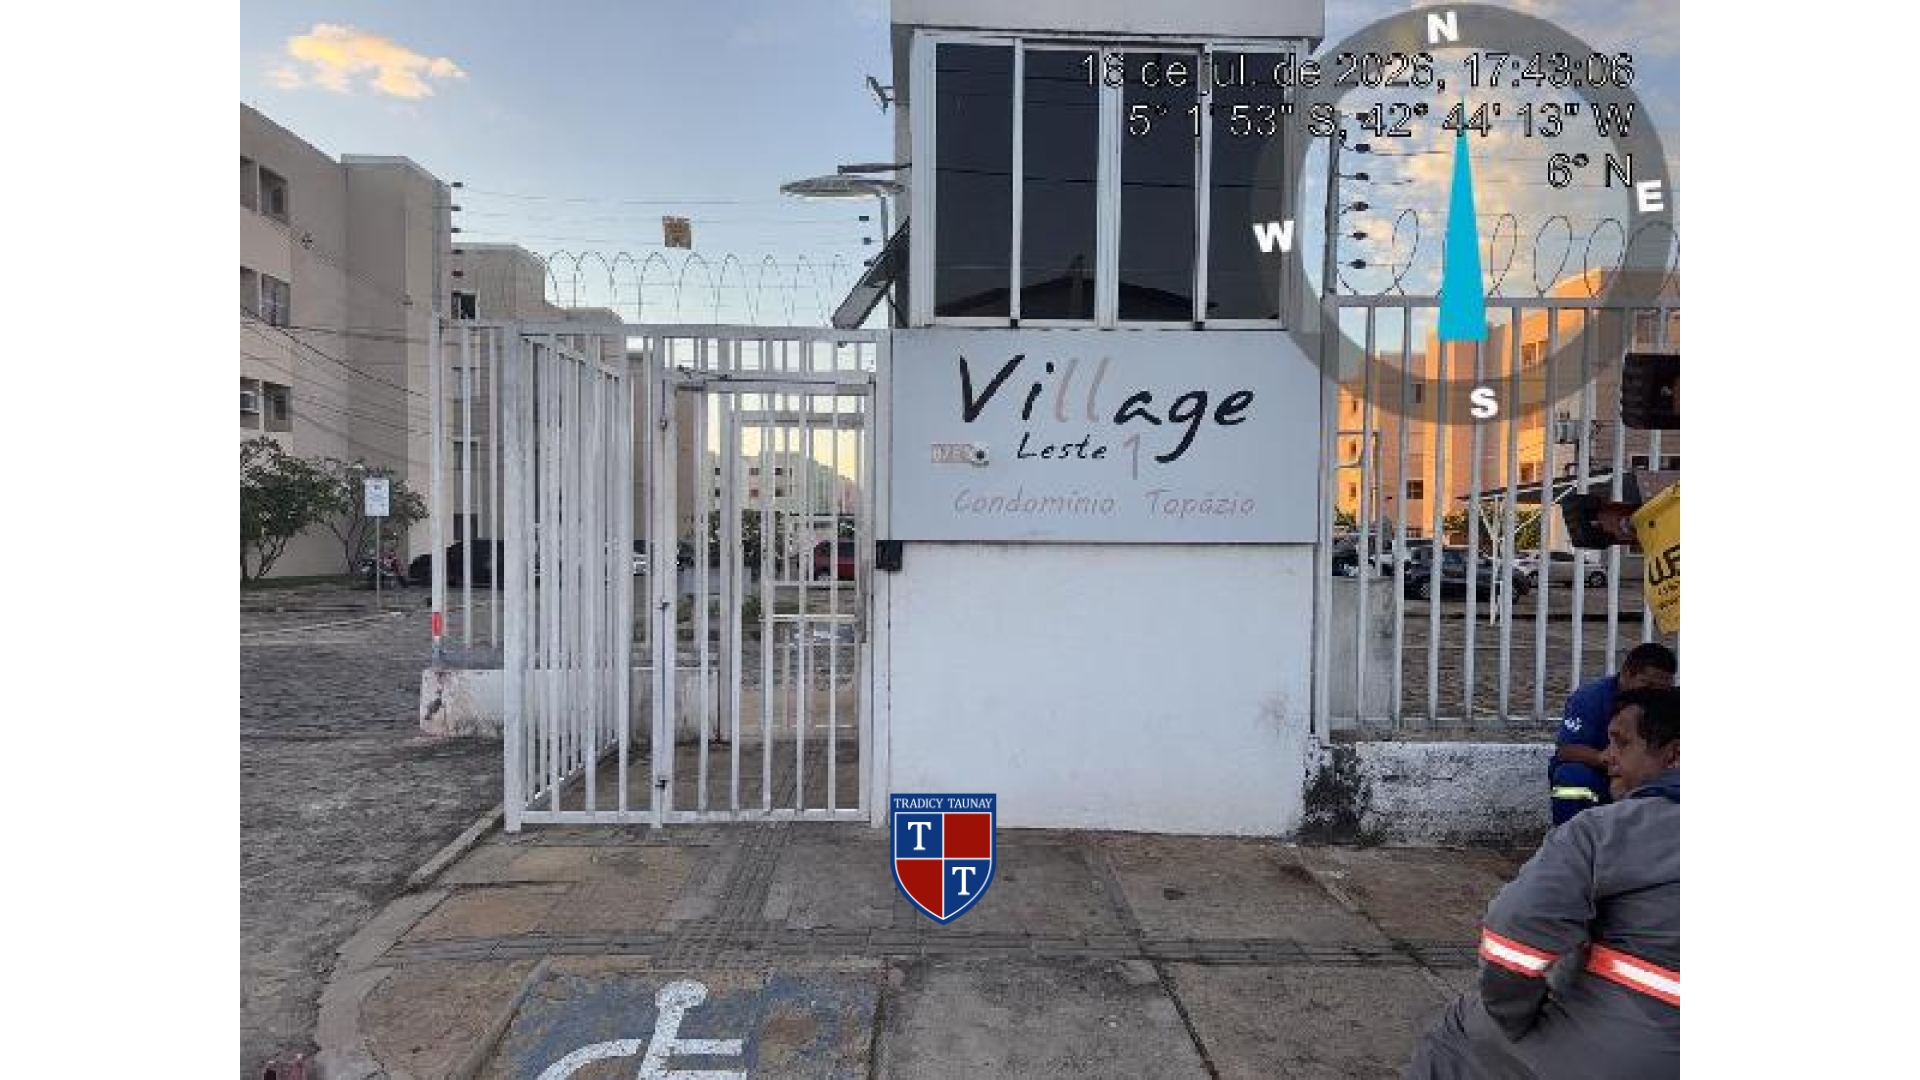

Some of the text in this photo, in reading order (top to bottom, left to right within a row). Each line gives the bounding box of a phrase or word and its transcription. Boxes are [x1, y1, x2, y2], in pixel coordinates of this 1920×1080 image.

[959, 354, 1255, 464] Village
[1017, 432, 1141, 480] Leste 1
